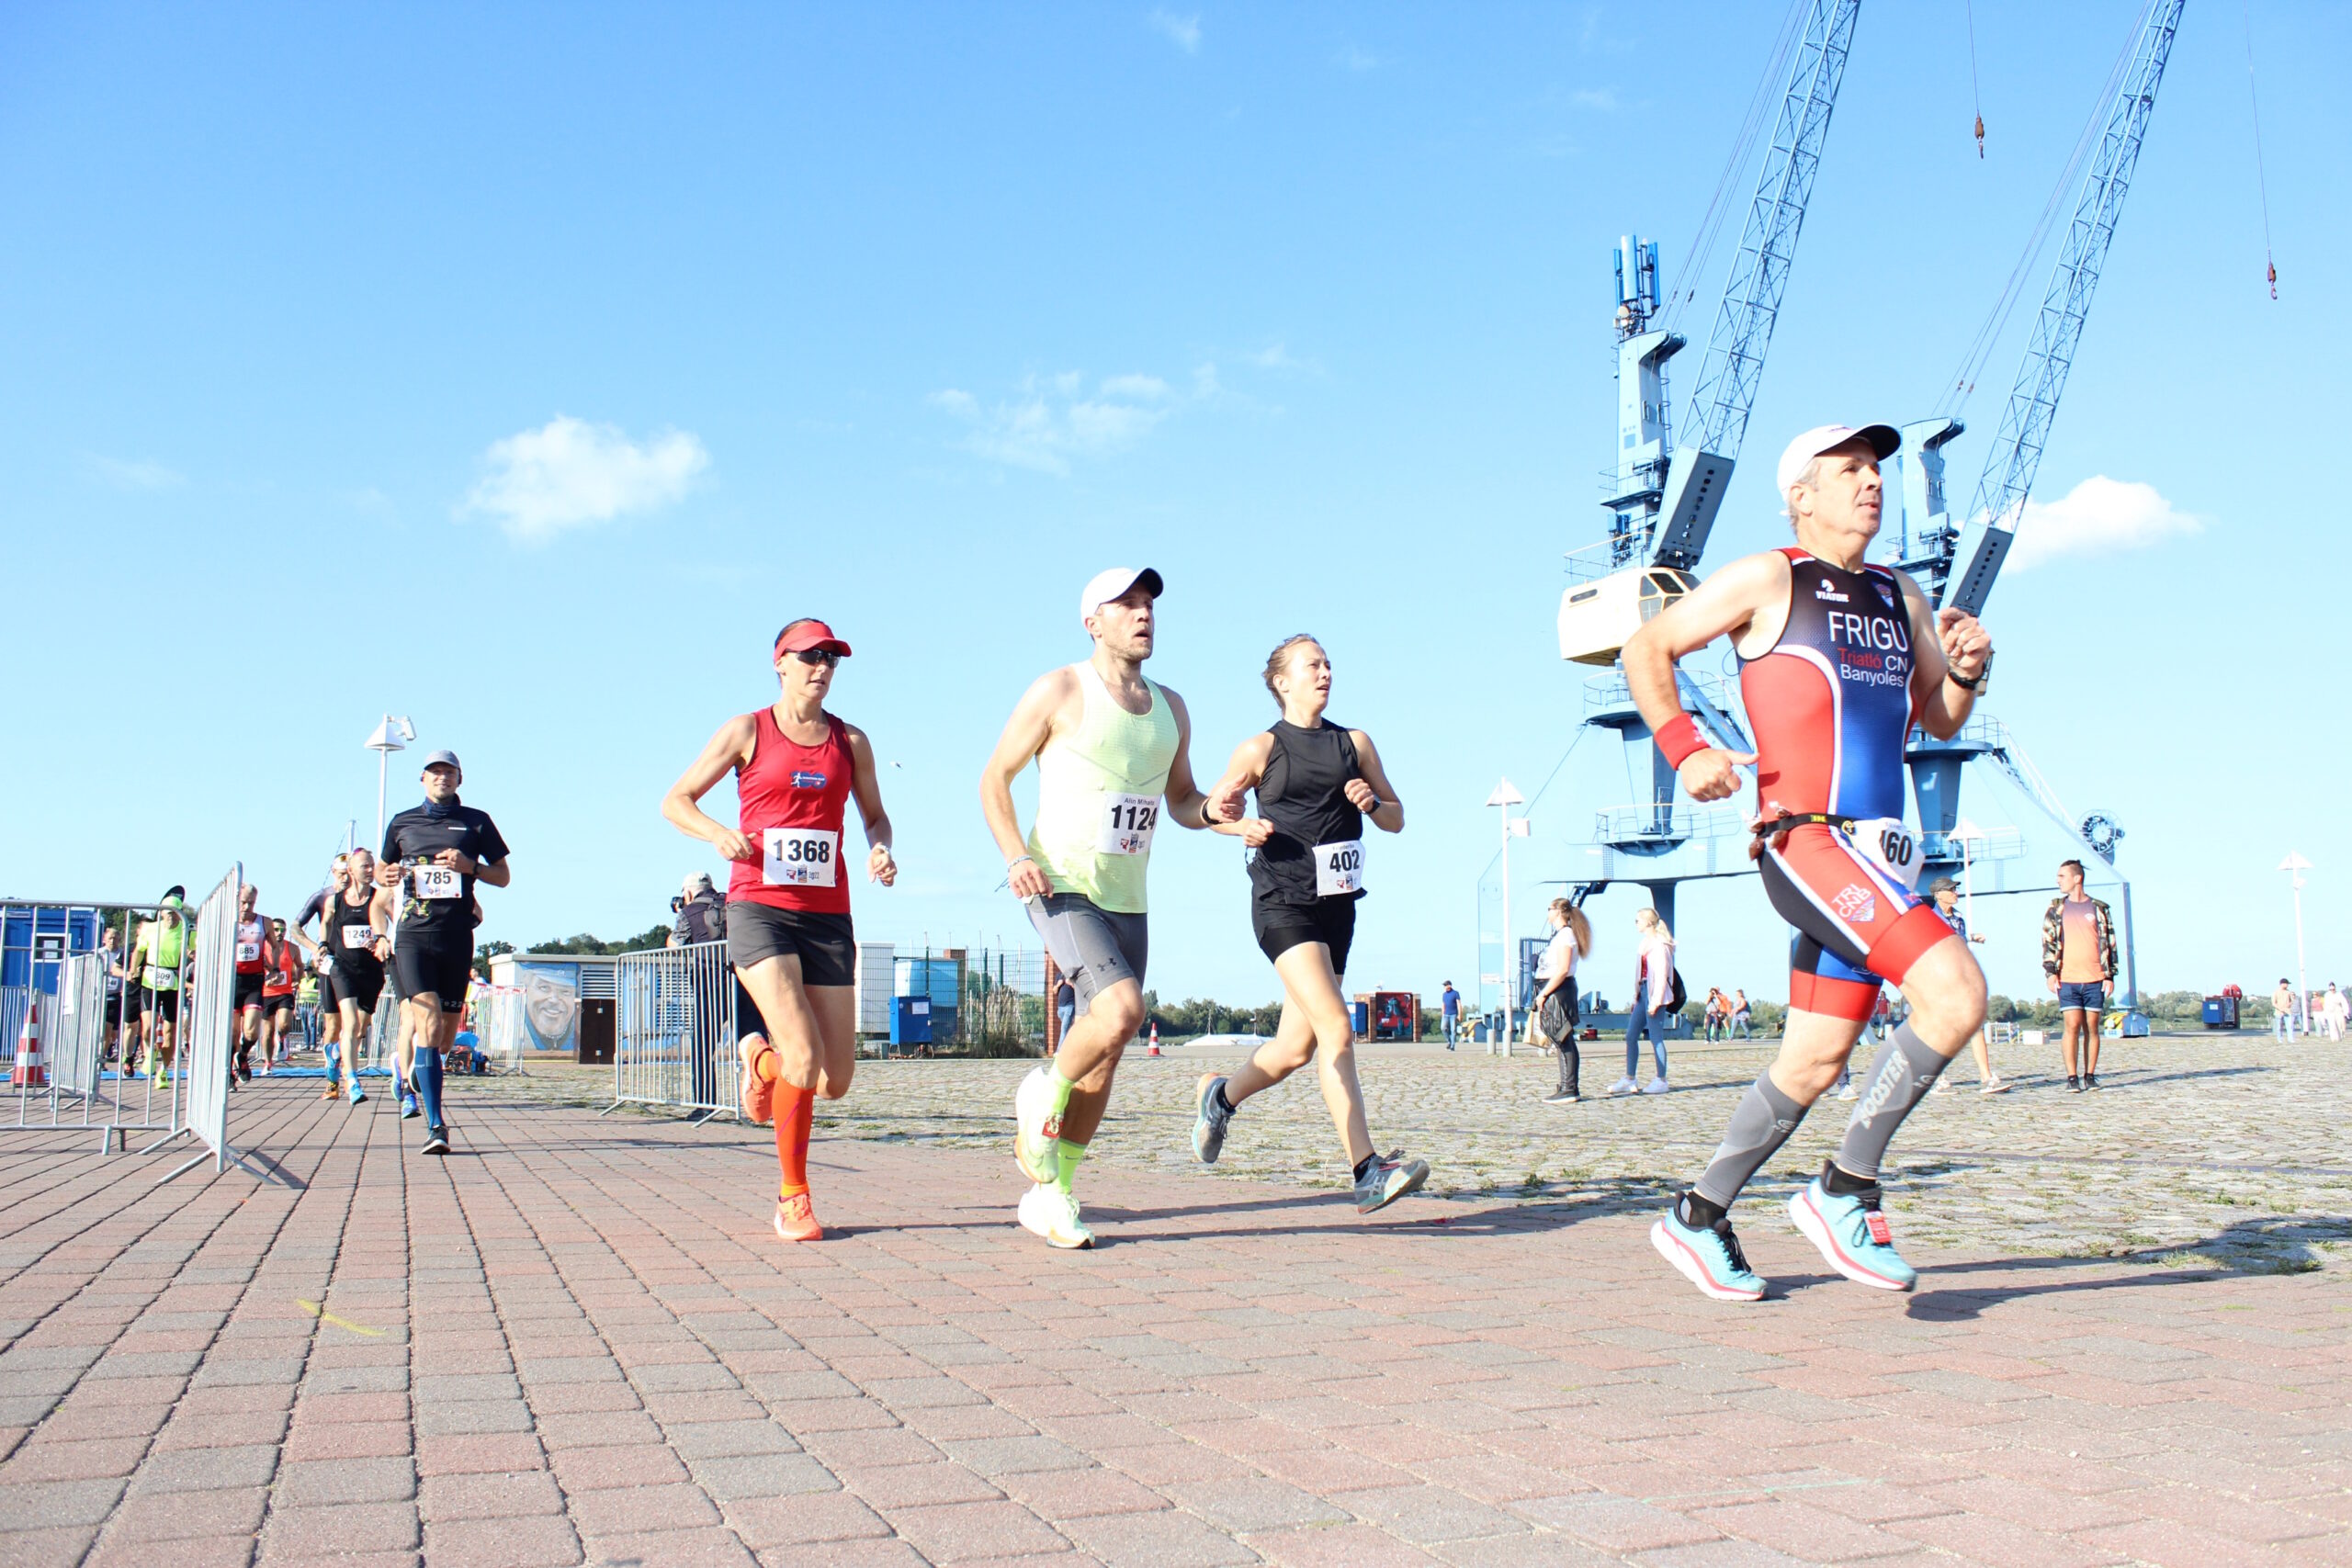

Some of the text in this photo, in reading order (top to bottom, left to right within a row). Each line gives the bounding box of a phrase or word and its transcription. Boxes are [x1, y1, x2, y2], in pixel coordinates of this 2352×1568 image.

[1828, 611, 1908, 652] FRIGU
[1840, 663, 1905, 687] Banyoles
[1885, 655, 1908, 672] CN
[1111, 805, 1158, 830] 1124
[773, 839, 831, 863] 1368
[1329, 850, 1360, 873] 402
[424, 871, 452, 885] 785
[1831, 883, 1860, 907] TRI
[1838, 887, 1871, 918] CNB
